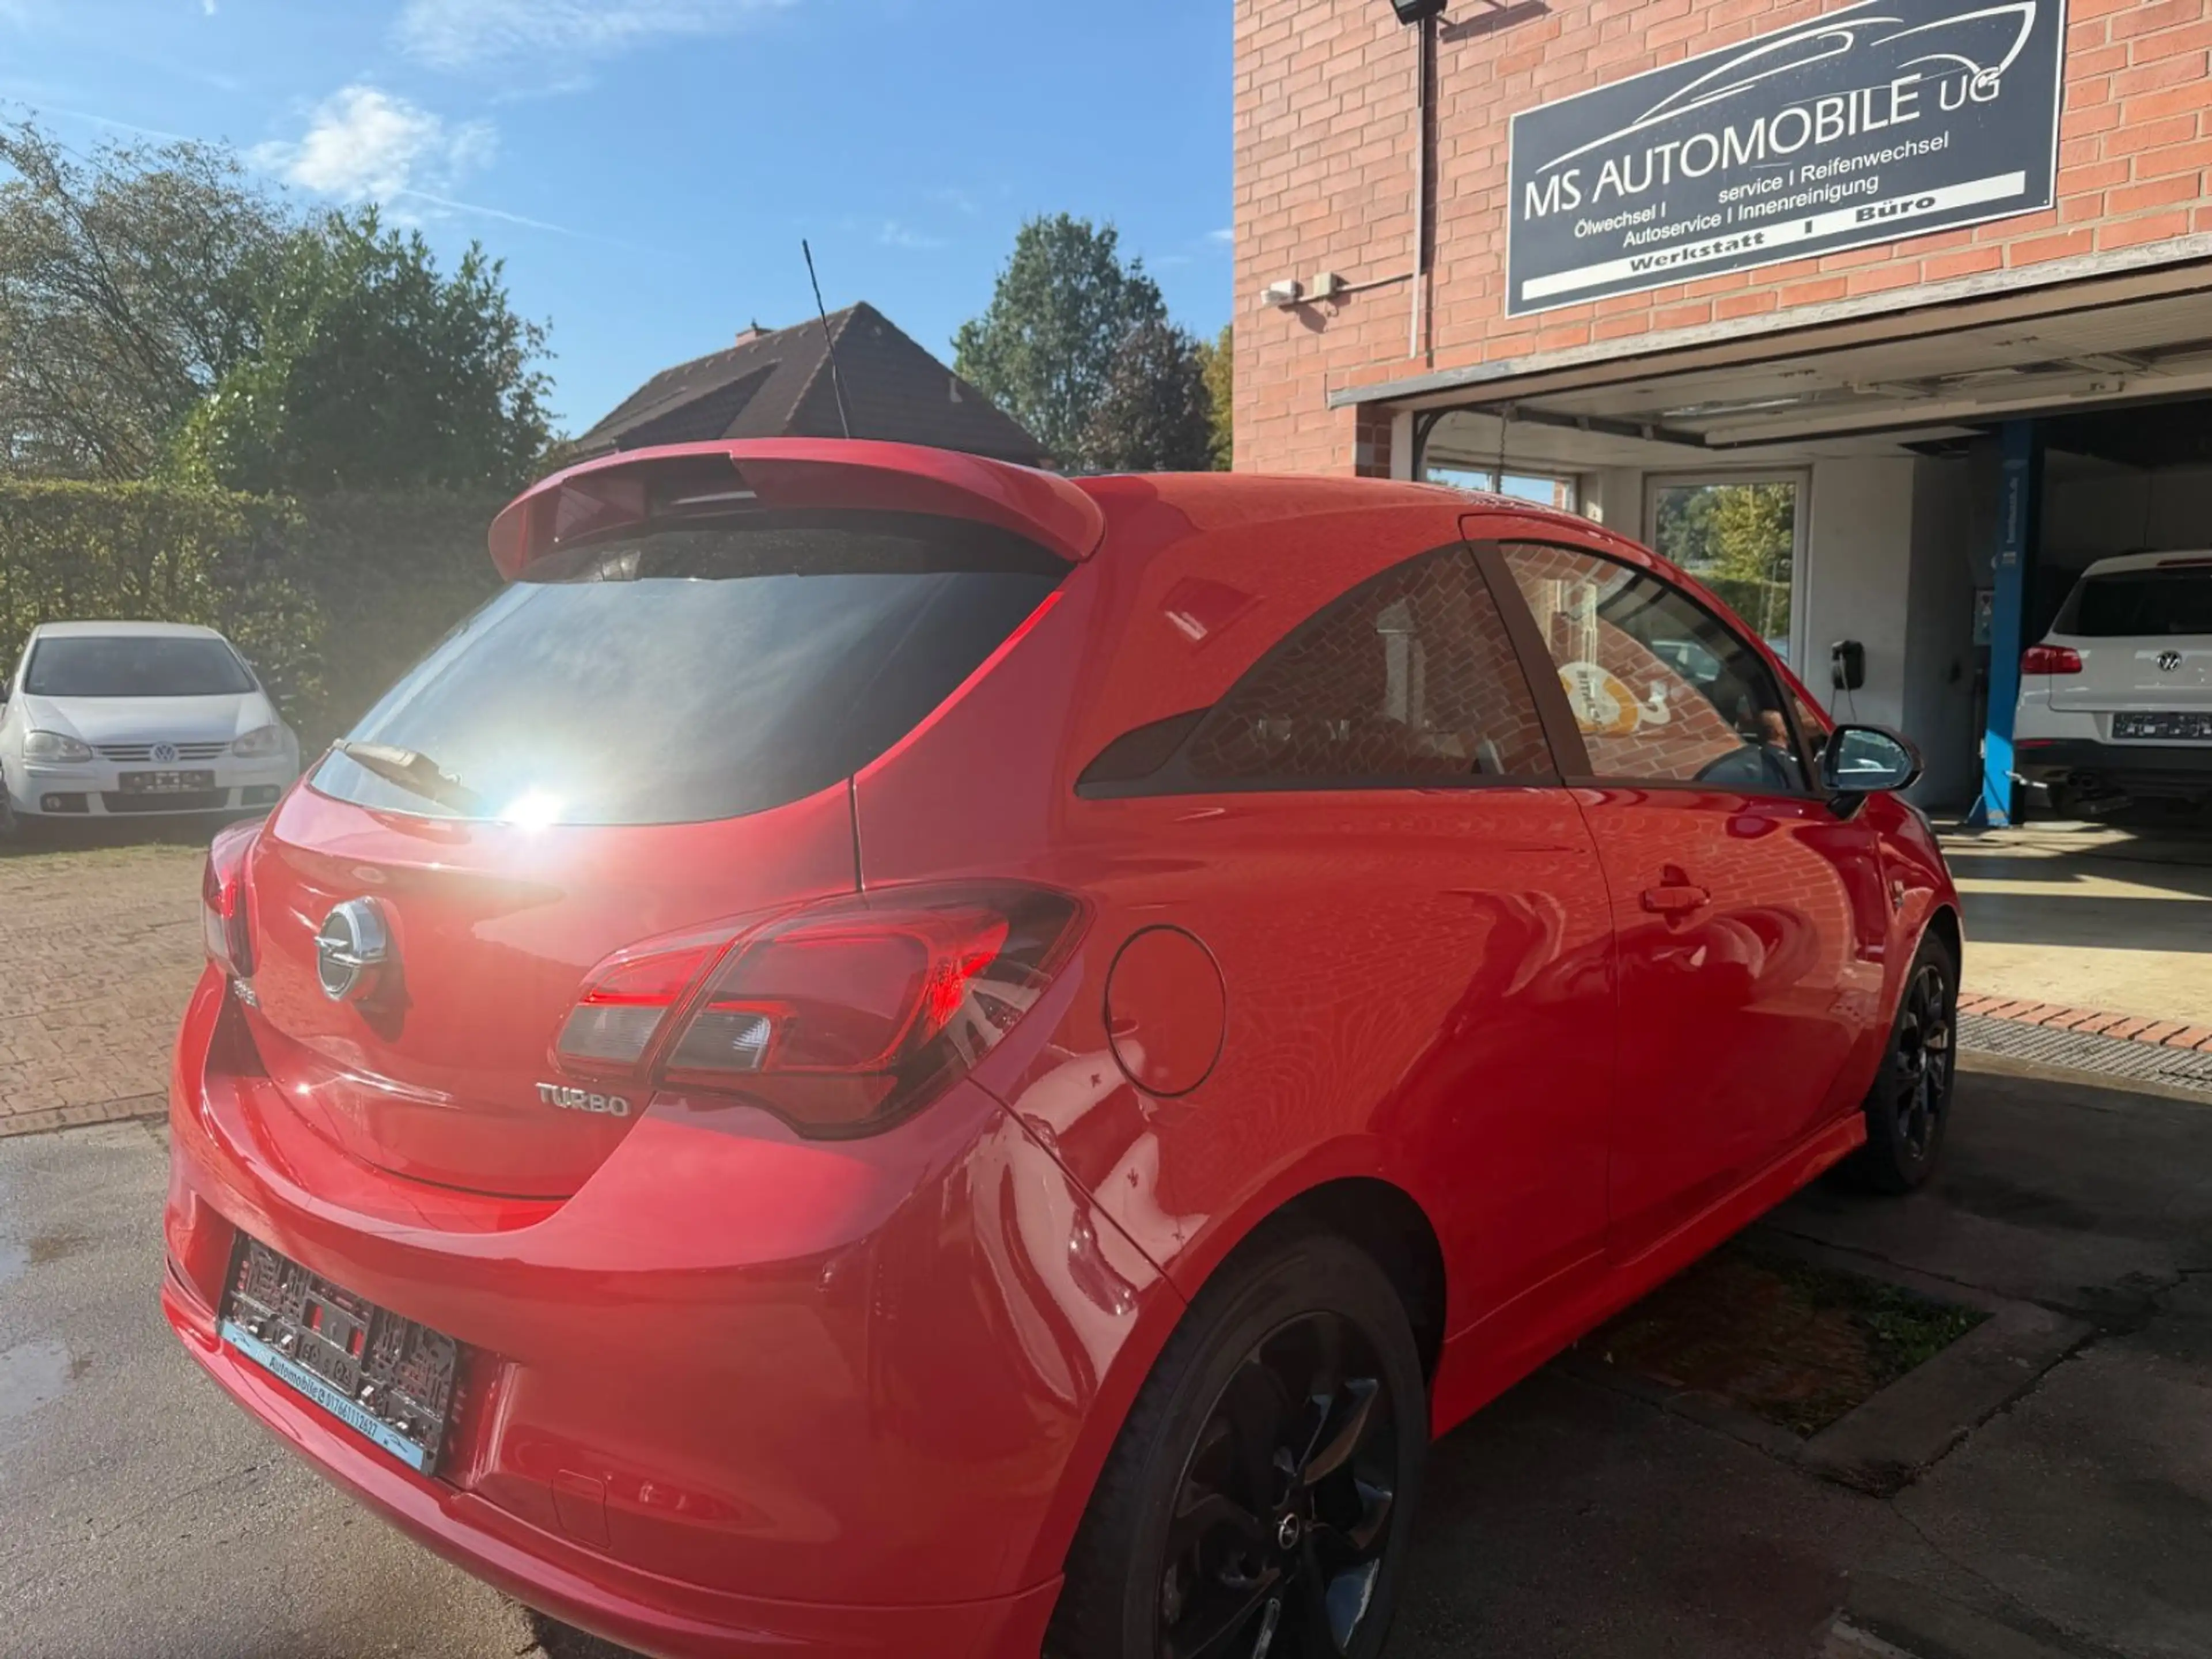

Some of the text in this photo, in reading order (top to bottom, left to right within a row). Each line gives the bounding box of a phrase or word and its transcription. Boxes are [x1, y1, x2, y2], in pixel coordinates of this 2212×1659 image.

[1524, 66, 2000, 221] MS AUTOMOBILE UG
[1574, 204, 1656, 238] Ölwechsel
[1718, 173, 1783, 203] service
[1800, 131, 1949, 183] Reifenwechsel
[1623, 214, 1721, 248] Autoservice
[1738, 175, 1879, 221] Innenreinigung
[1630, 232, 1765, 272] Werkstatt
[1855, 196, 1936, 223] Büro
[535, 1082, 631, 1116] TURBO
